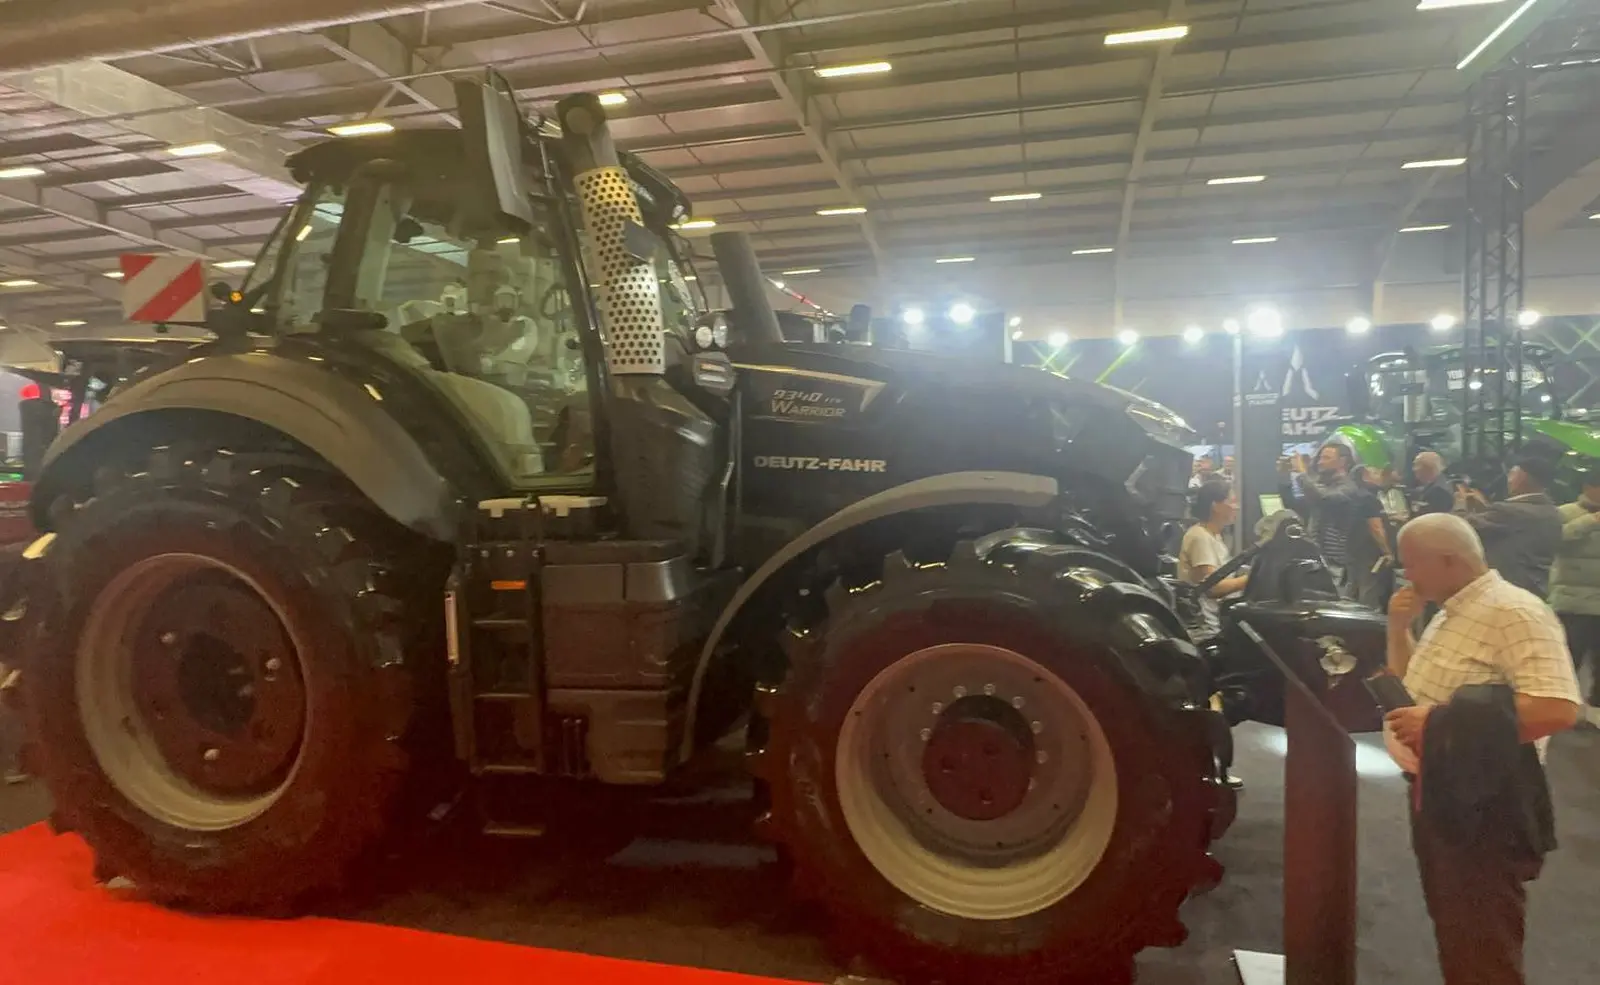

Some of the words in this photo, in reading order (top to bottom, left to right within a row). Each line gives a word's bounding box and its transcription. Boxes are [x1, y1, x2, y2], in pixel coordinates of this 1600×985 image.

[771, 399, 847, 417] WARRIOR
[1281, 406, 1338, 421] EUTZ
[754, 455, 887, 473] DEUTZ-FAHR
